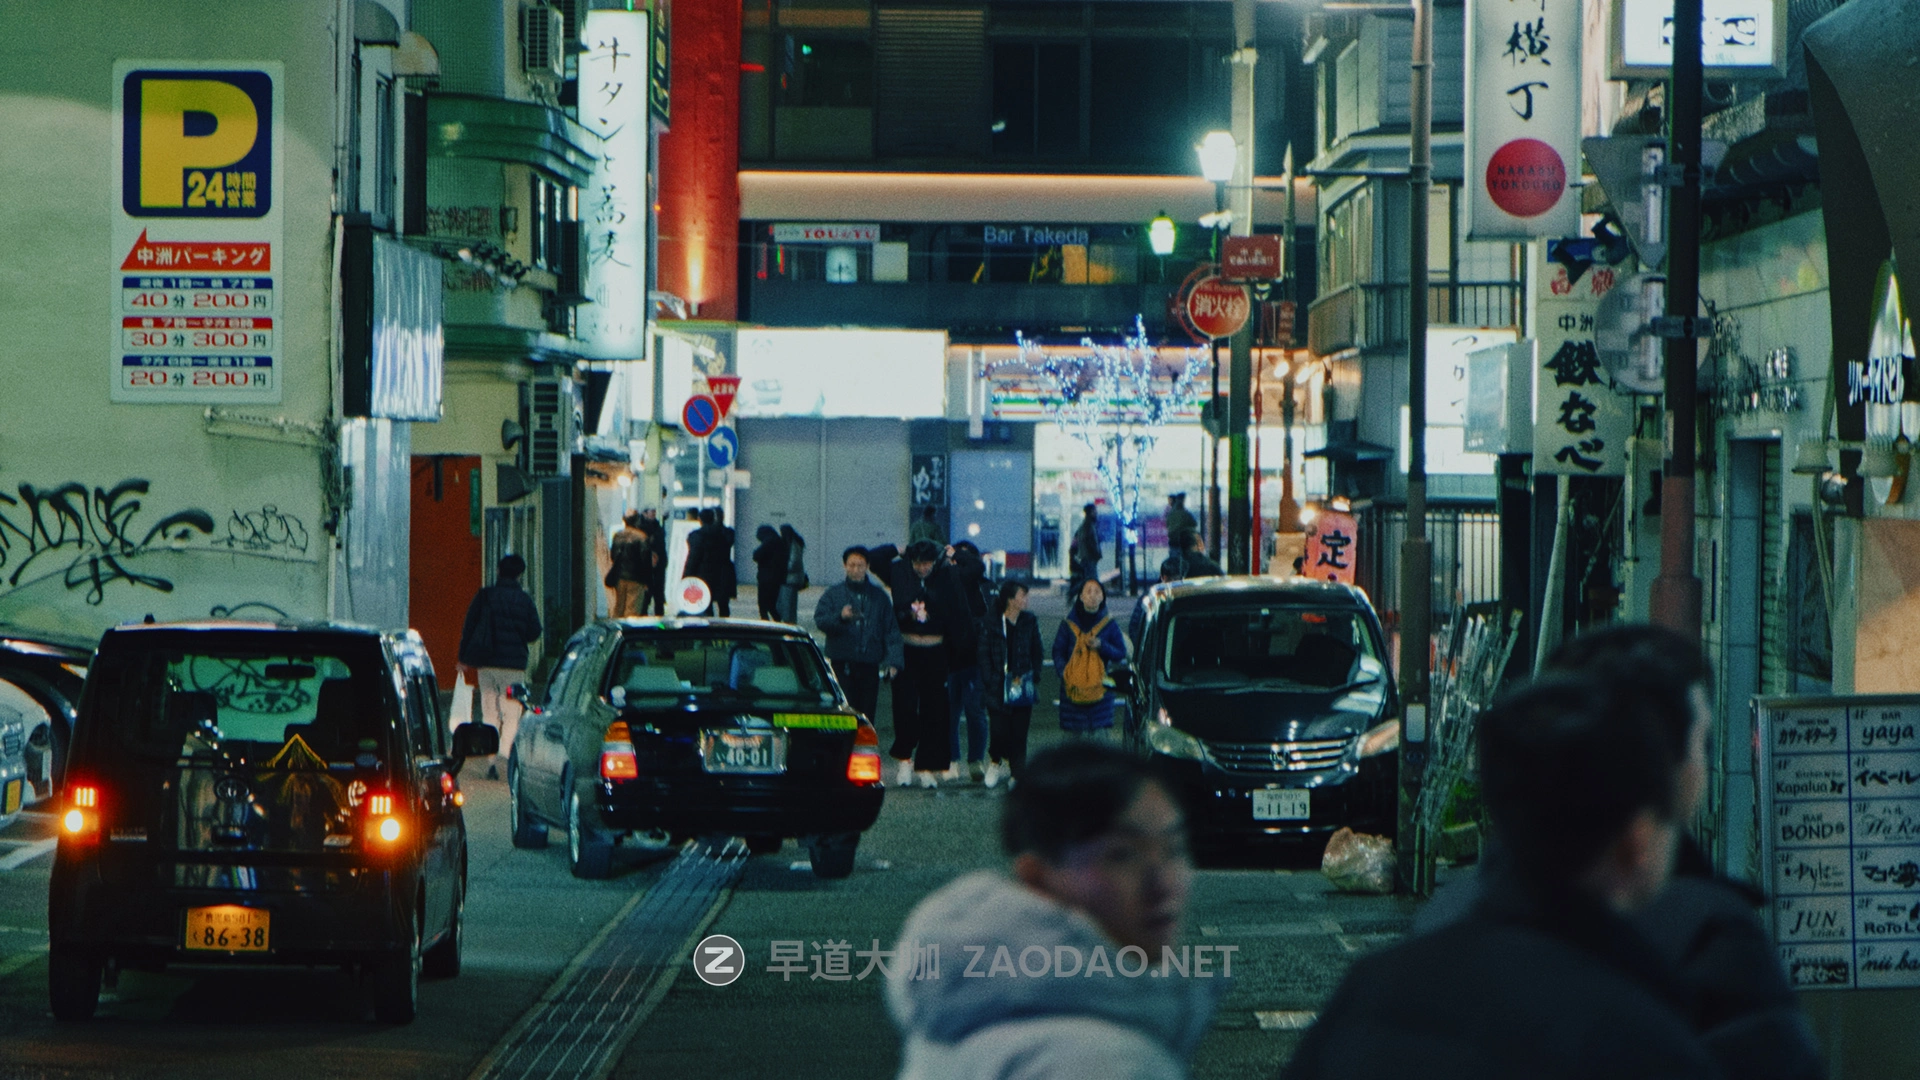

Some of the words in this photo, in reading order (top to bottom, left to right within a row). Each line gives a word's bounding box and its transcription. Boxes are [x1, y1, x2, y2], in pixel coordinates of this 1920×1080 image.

[1502, 0, 1551, 122] 横丁
[140, 79, 258, 208] P
[588, 36, 633, 268] 牛タンと蕎麦
[1497, 166, 1556, 176] NAKASU
[187, 171, 225, 208] 24
[1492, 180, 1561, 191] YOKOCHO
[984, 226, 1014, 244] Bar
[1022, 226, 1089, 244] Takeda
[131, 292, 186, 308] 40分
[193, 292, 267, 308] 200円
[1194, 293, 1245, 320] 消火栓
[131, 331, 186, 347] 30分
[193, 331, 267, 347] 300円
[130, 370, 186, 386] 20分
[193, 370, 267, 386] 200円
[1543, 339, 1605, 473] 鉄なべ
[1316, 529, 1352, 581] 定
[1862, 724, 1915, 746] yaya
[1776, 781, 1828, 797] Kapalua
[1782, 824, 1834, 841] BOND
[1789, 911, 1837, 935] JUN
[204, 926, 264, 947] 86-38
